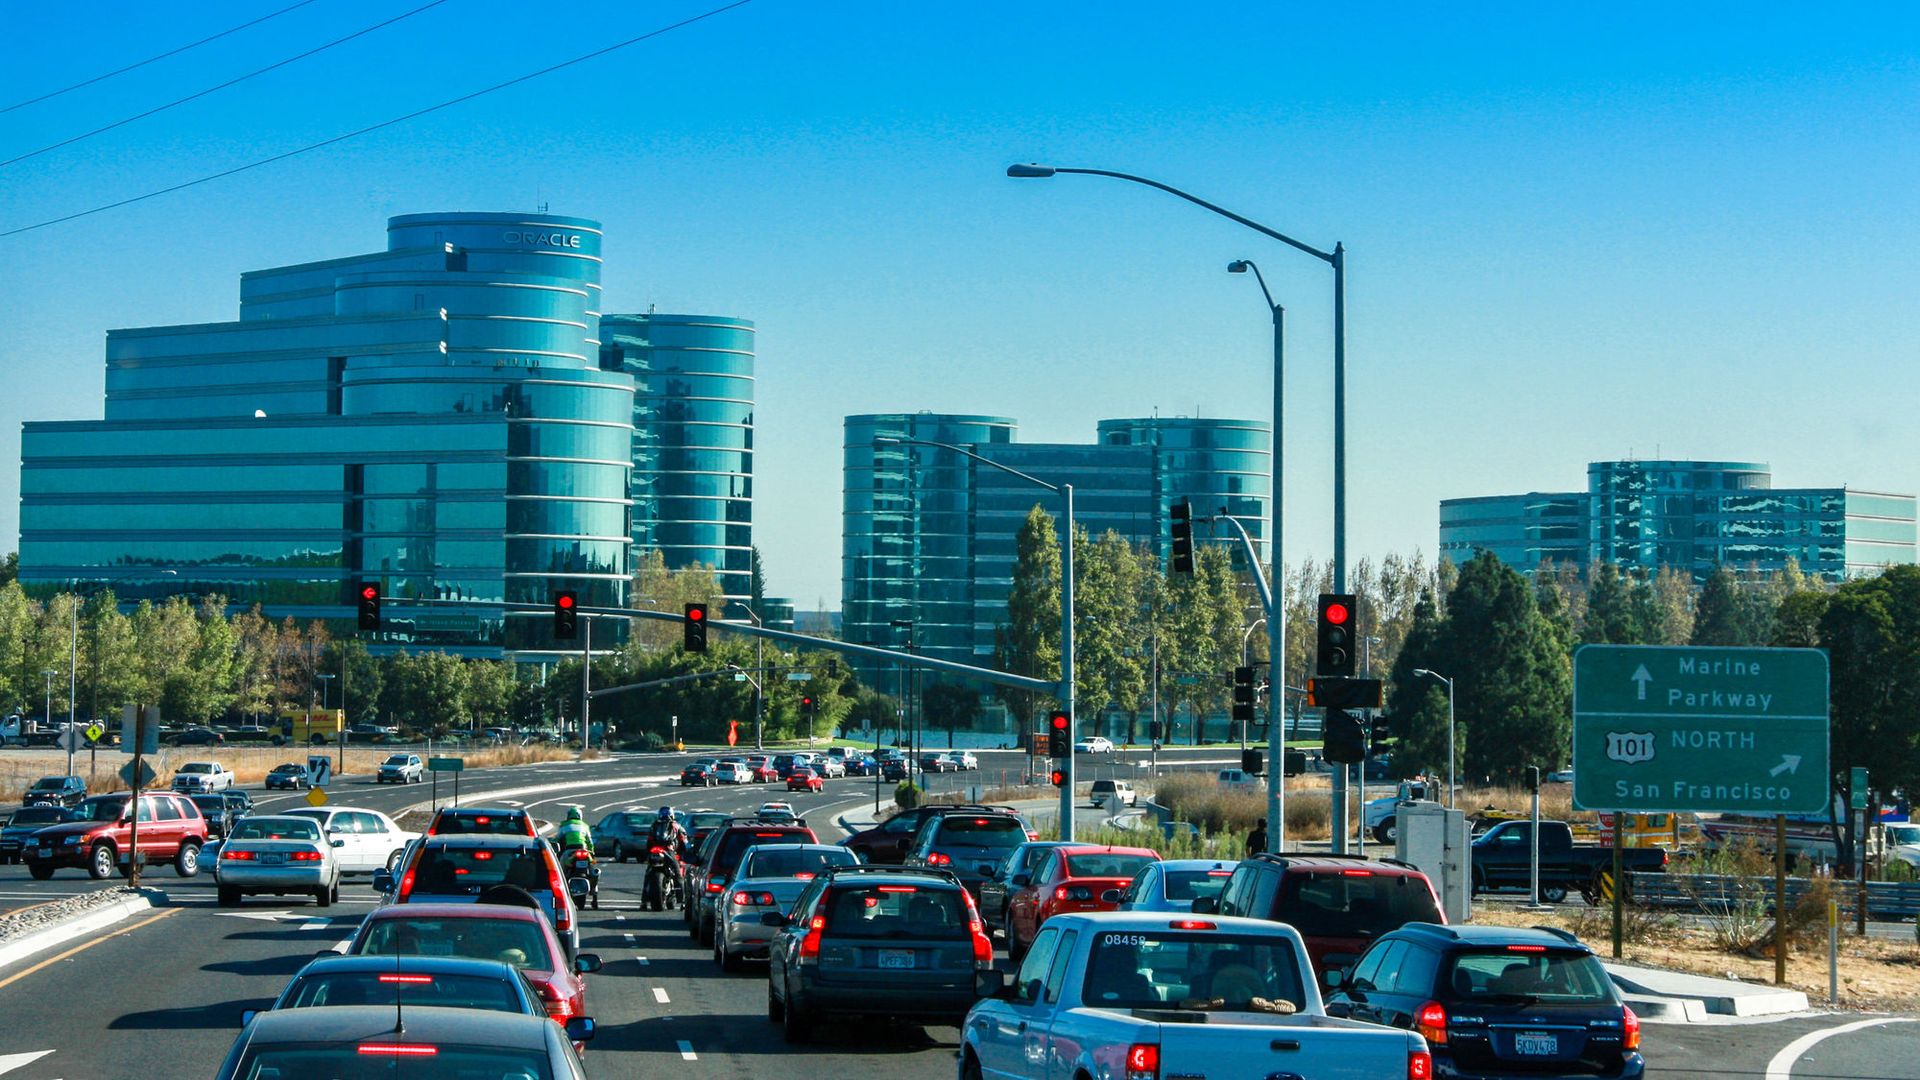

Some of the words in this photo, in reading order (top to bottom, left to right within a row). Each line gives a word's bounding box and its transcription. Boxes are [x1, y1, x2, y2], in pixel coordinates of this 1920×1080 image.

[503, 231, 581, 248] ORACLE
[1679, 657, 1761, 675] Marine
[1668, 688, 1773, 711] Parkway
[1616, 739, 1646, 756] 101
[1671, 730, 1755, 749] NORTH
[1615, 780, 1660, 798] San
[1674, 781, 1791, 800] Francisco
[1105, 934, 1146, 946] 08458
